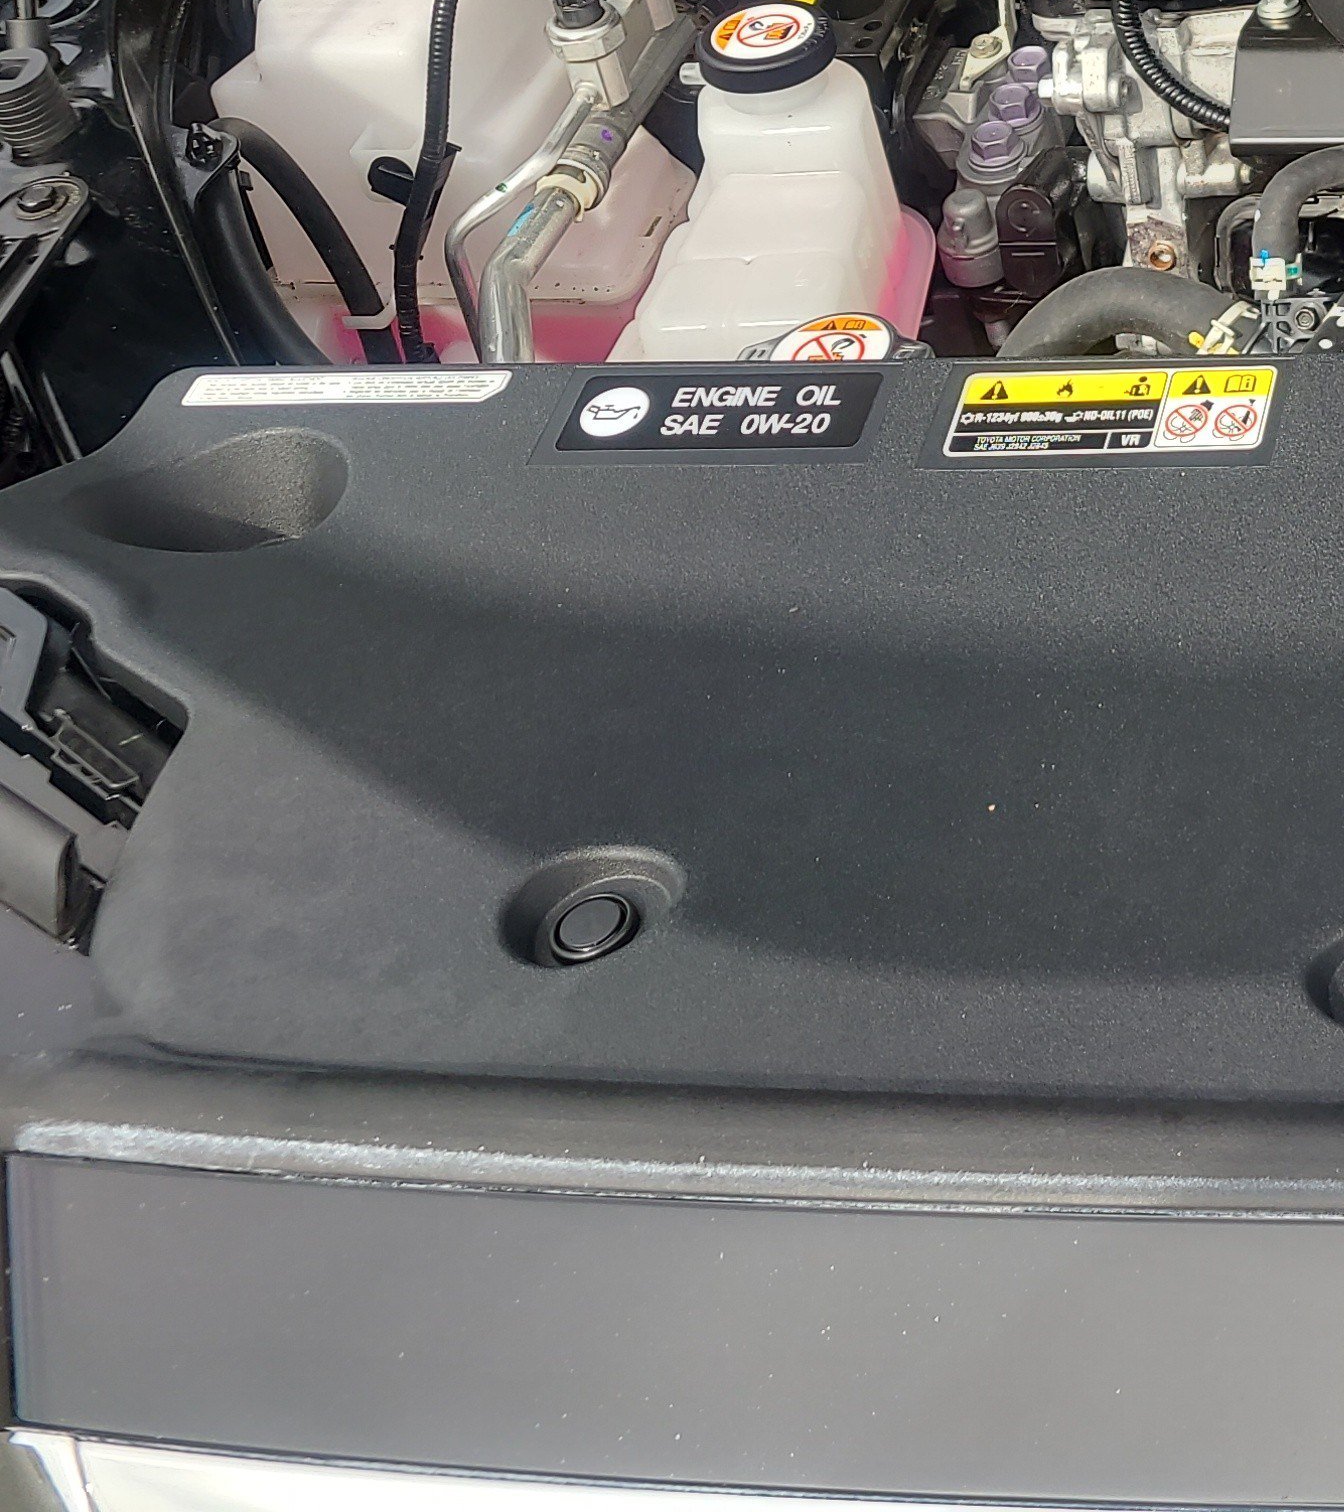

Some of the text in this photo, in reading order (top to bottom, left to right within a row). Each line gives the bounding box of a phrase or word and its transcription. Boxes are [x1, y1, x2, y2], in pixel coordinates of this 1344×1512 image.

[671, 385, 842, 407] ENGINE OIL
[660, 413, 831, 435] SAE 0W-20
[1127, 409, 1154, 422] (POE)
[977, 434, 1082, 444] TOYOTA MOTOR CORPORATION
